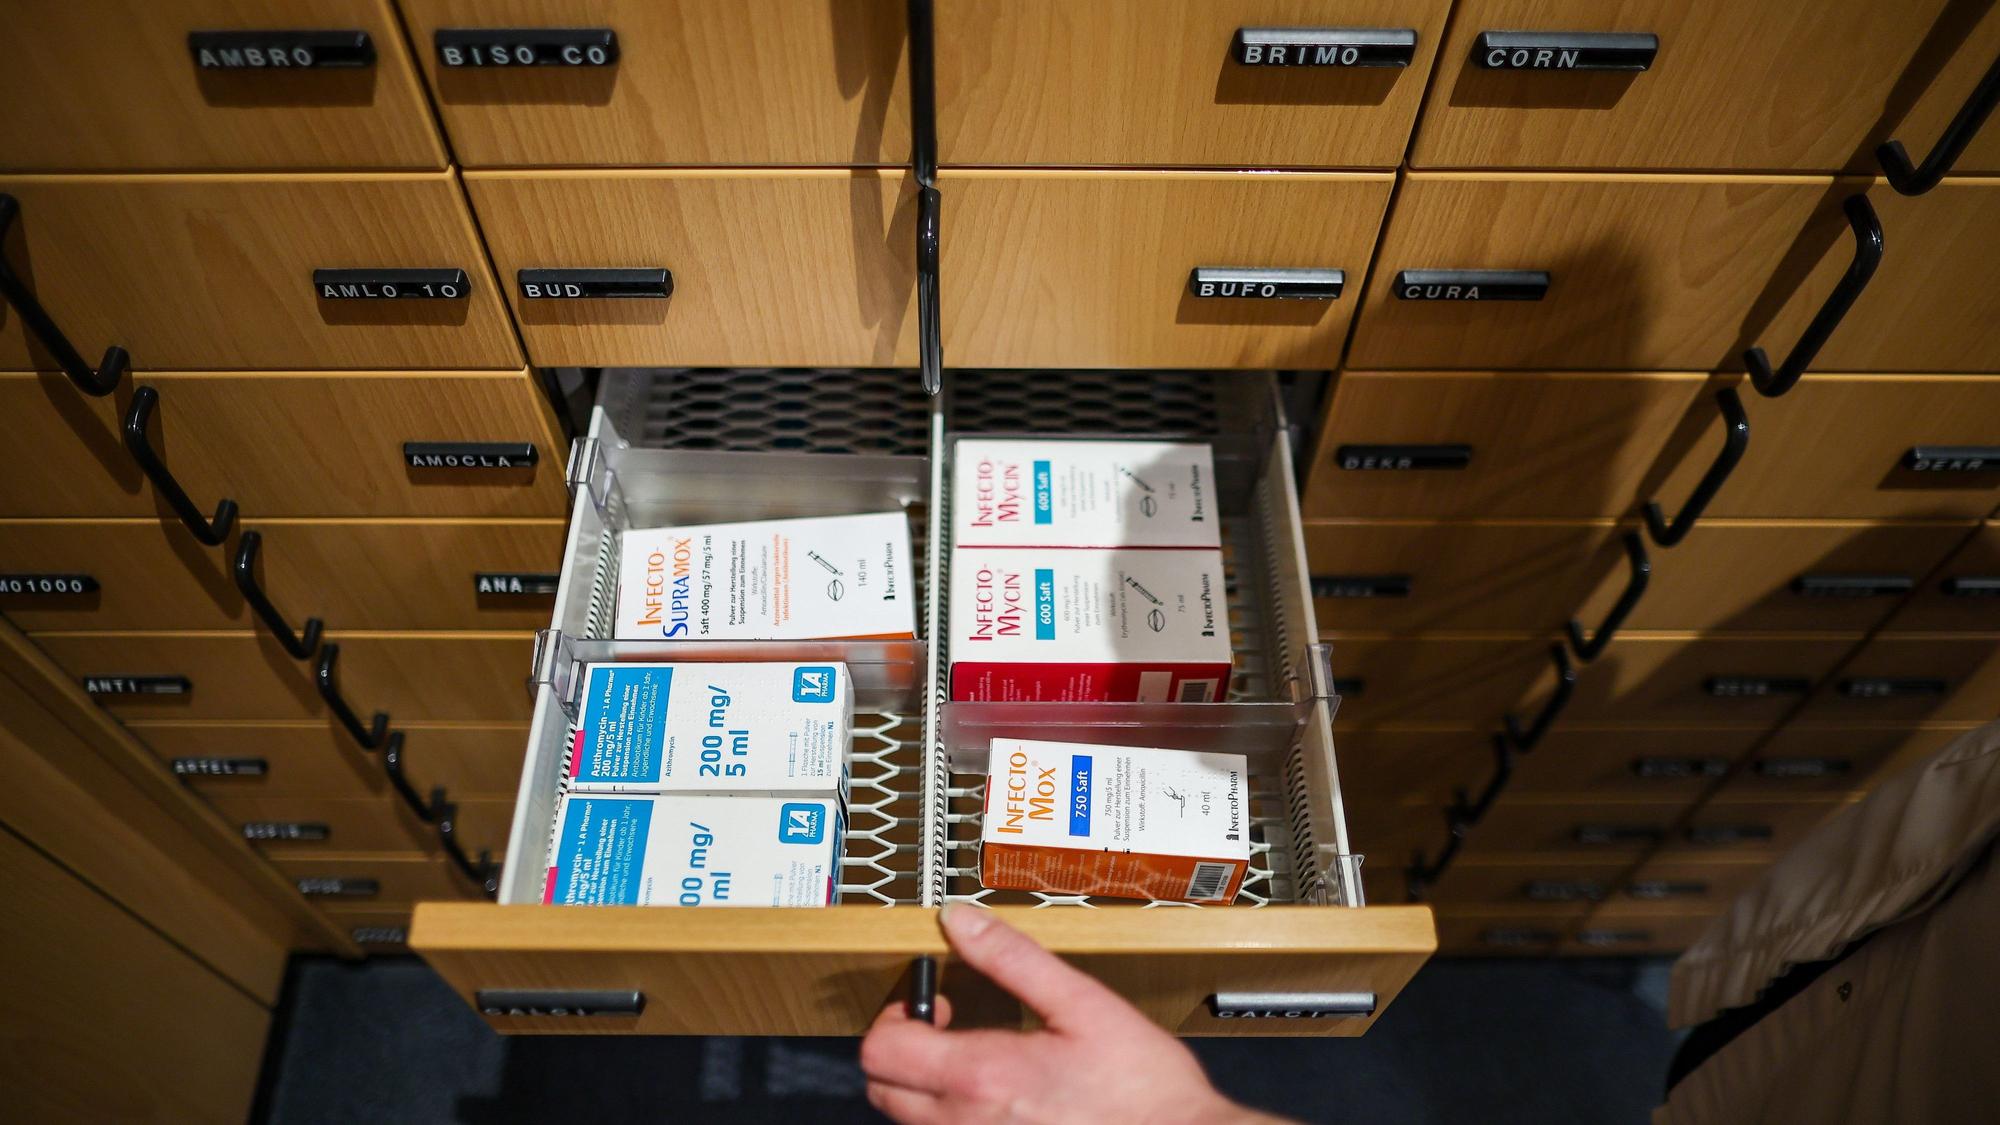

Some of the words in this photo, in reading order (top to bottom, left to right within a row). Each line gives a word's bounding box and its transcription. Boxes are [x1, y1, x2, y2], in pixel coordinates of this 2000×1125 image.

[200, 48, 312, 66] AMBRO
[443, 47, 533, 65] BISO
[563, 47, 605, 64] CO
[1244, 47, 1358, 65] BRIMO
[1487, 50, 1578, 68] CORN
[324, 285, 397, 297] AMLO
[526, 284, 580, 297] BUD
[1200, 283, 1276, 297] BUFO
[1405, 286, 1479, 299] CURA
[413, 455, 511, 467] AMOCLA
[480, 577, 522, 592] ANA
[729, 557, 739, 593] Herstellung
[1040, 582, 1051, 602] Saft
[701, 600, 710, 616] 400
[729, 605, 737, 626] Pulver
[738, 589, 748, 625] Suspension
[1040, 604, 1051, 625] 600
[700, 618, 710, 635] Saft
[820, 672, 829, 697] PHARMA
[641, 691, 649, 700] ab
[637, 701, 647, 722] Kinder
[708, 685, 730, 728] mg/
[608, 721, 617, 732] ml
[616, 702, 630, 741] Herstellung
[621, 737, 632, 777] Suspension
[628, 684, 639, 720] Einnehmen
[635, 722, 644, 733] für
[640, 738, 652, 777] Jugendliche
[647, 684, 658, 722] Erwachsene
[591, 717, 608, 777] Azithromycin
[604, 734, 616, 757] mg/5
[614, 742, 622, 753] zur
[728, 730, 749, 756] ml
[611, 755, 621, 777] Pulver
[631, 734, 643, 777] Antibiotikum
[665, 736, 675, 777] Azithromycin
[699, 736, 722, 777] 200
[601, 760, 611, 777] 200
[725, 763, 746, 777] 5
[1076, 770, 1088, 793] Saft
[1105, 777, 1112, 785] ml
[1114, 773, 1123, 808] Herstellung
[1105, 786, 1113, 803] mg/5
[1200, 791, 1210, 802] ml
[1075, 795, 1087, 818] 750
[1201, 804, 1210, 816] 40
[809, 811, 819, 838] PHARMA
[1113, 820, 1121, 840] Pulver
[1123, 806, 1132, 841] Suspension
[591, 838, 606, 880] Herstellung
[600, 818, 608, 837] einer
[604, 819, 617, 858] Einnehmen
[614, 837, 625, 860] Kinder
[624, 818, 638, 861] Erwachsene
[689, 822, 713, 869] mg/
[582, 859, 592, 870] ml
[601, 860, 609, 875] zum
[564, 854, 583, 906] ithromycin
[710, 872, 731, 900] ml
[679, 877, 703, 906] 00
